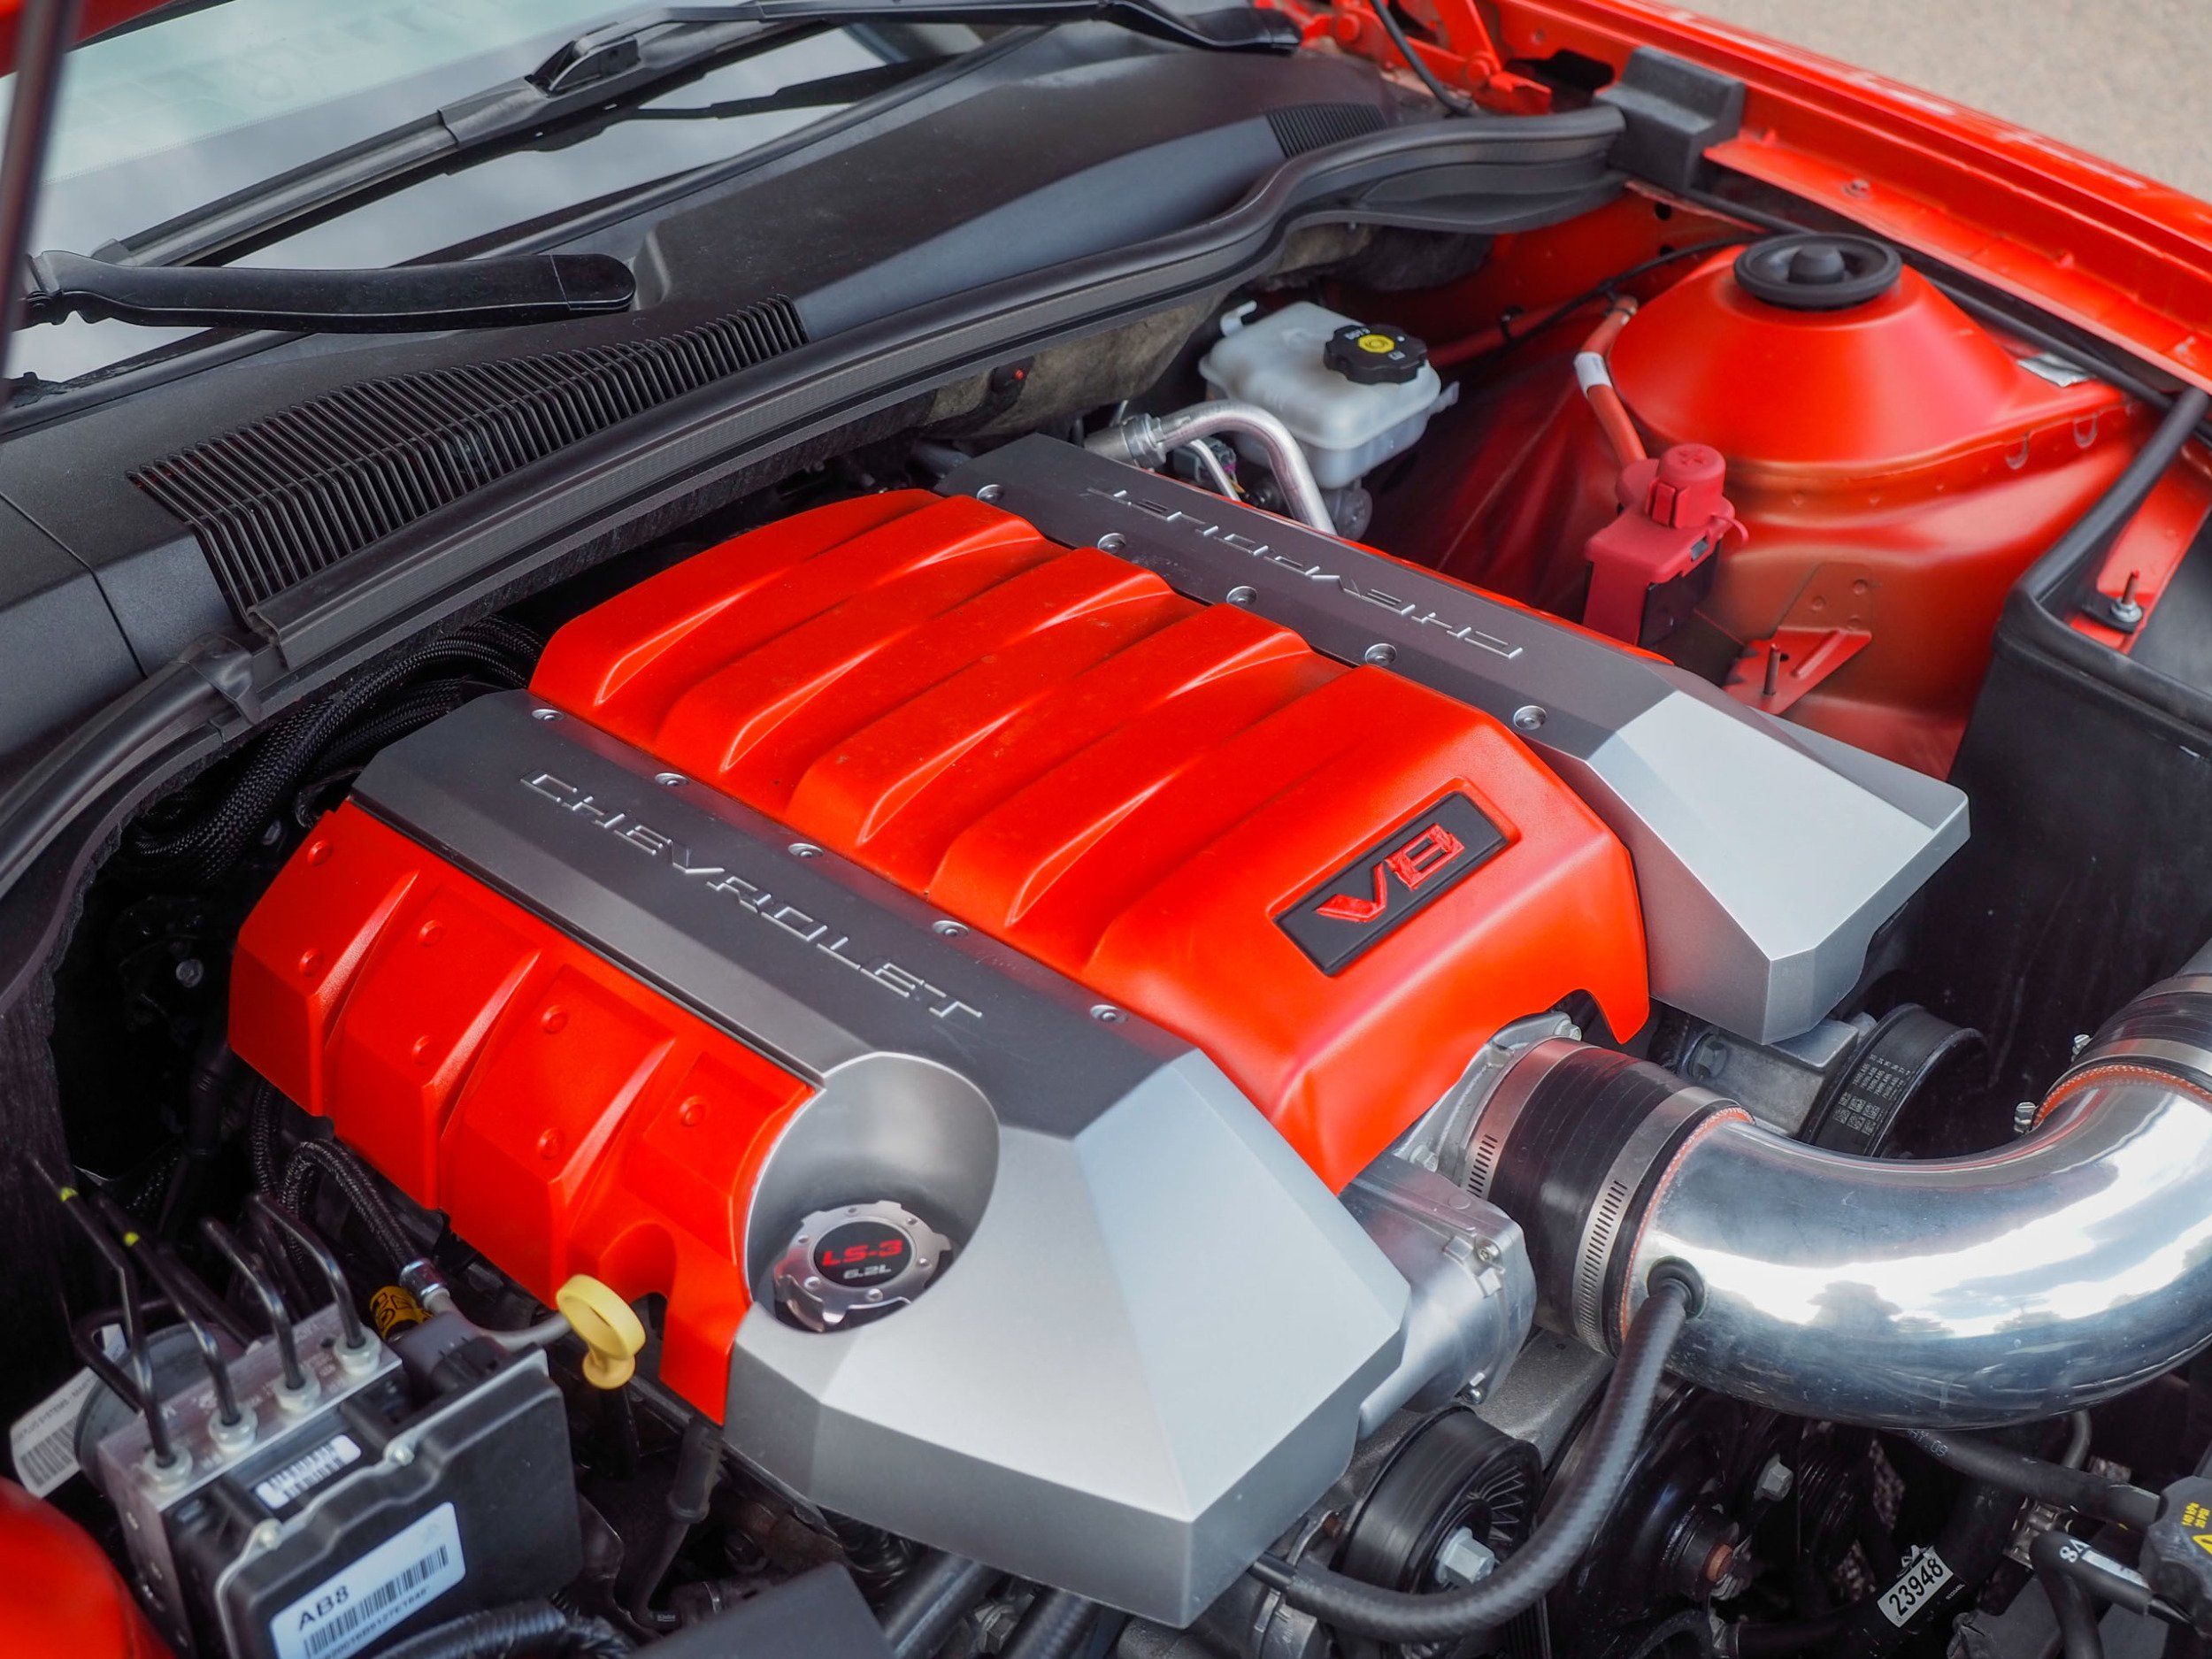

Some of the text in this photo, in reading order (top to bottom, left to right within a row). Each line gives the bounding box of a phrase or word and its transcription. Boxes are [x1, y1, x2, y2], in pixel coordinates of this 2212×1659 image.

[1085, 487, 1524, 659] CHEVROLET
[519, 772, 983, 1018] CHEVROLET
[1314, 822, 1465, 923] V8
[822, 1239, 904, 1267] LS-3
[843, 1263, 892, 1279] 6.2L
[298, 1586, 349, 1623] AB8
[1888, 1557, 1944, 1617] 23948
